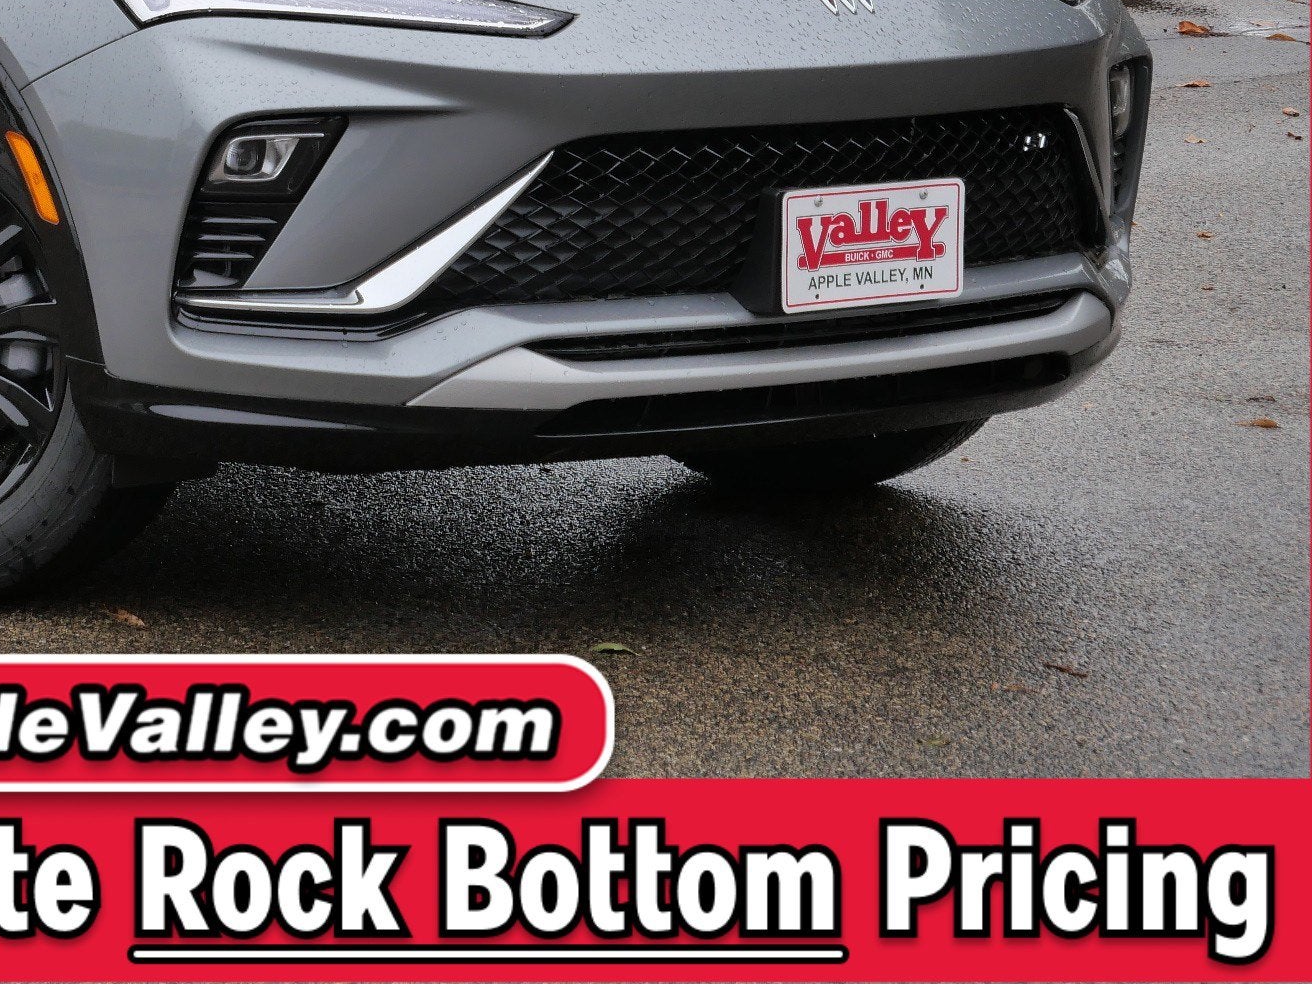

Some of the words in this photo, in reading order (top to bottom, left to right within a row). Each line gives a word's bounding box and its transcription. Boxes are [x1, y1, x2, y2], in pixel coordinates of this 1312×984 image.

[796, 198, 950, 272] Valley
[844, 249, 870, 262] BUICK
[875, 248, 894, 261] GMC
[808, 272, 852, 291] APPLE
[855, 267, 909, 286] VALLEY,
[912, 265, 934, 281] MN
